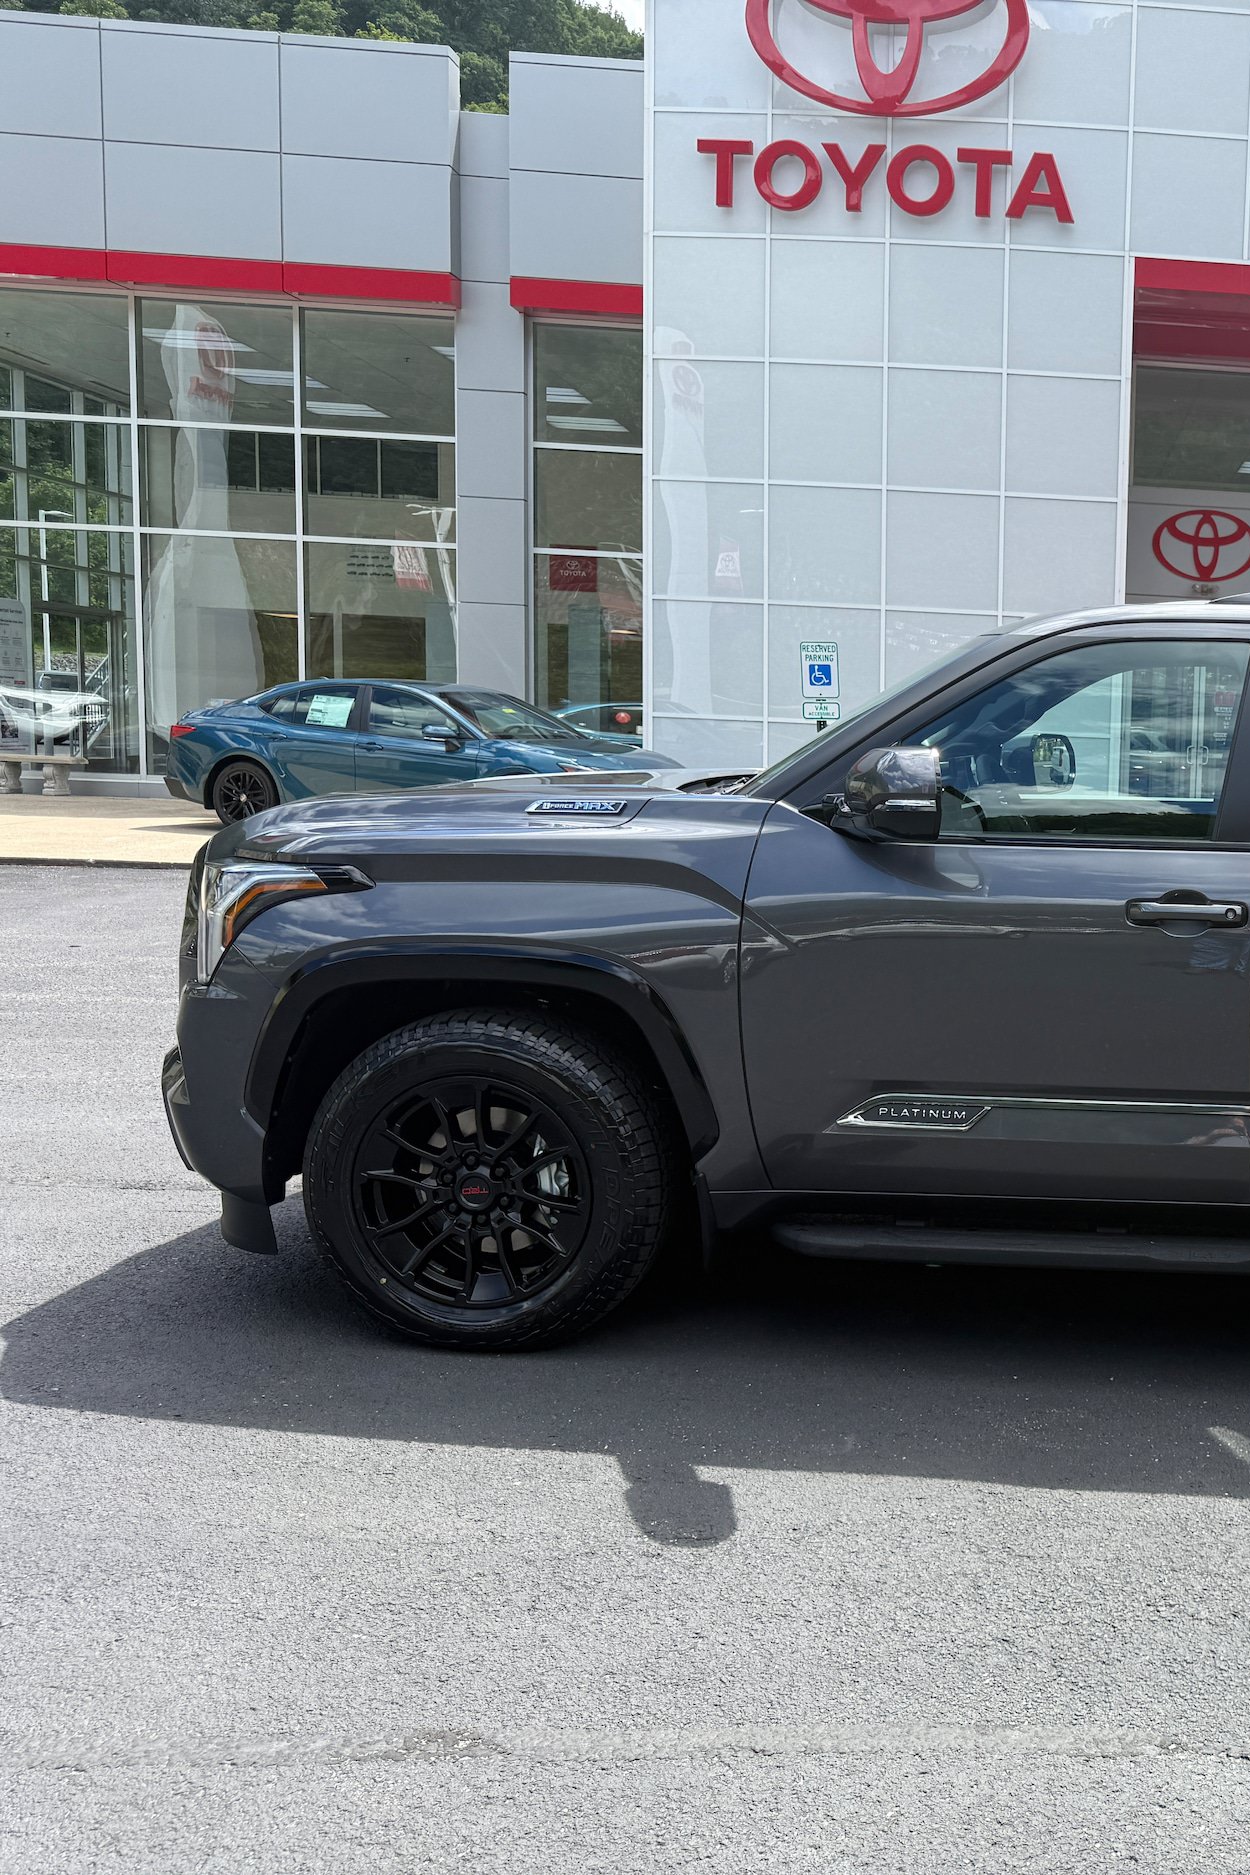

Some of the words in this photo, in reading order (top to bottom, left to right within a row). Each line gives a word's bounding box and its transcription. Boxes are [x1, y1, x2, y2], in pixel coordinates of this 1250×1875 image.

[697, 139, 1074, 224] TOYOTA
[802, 644, 836, 653] RESERVED
[805, 654, 834, 662] PARKING
[574, 801, 615, 811] MAX
[879, 1107, 966, 1119] PLATINUM
